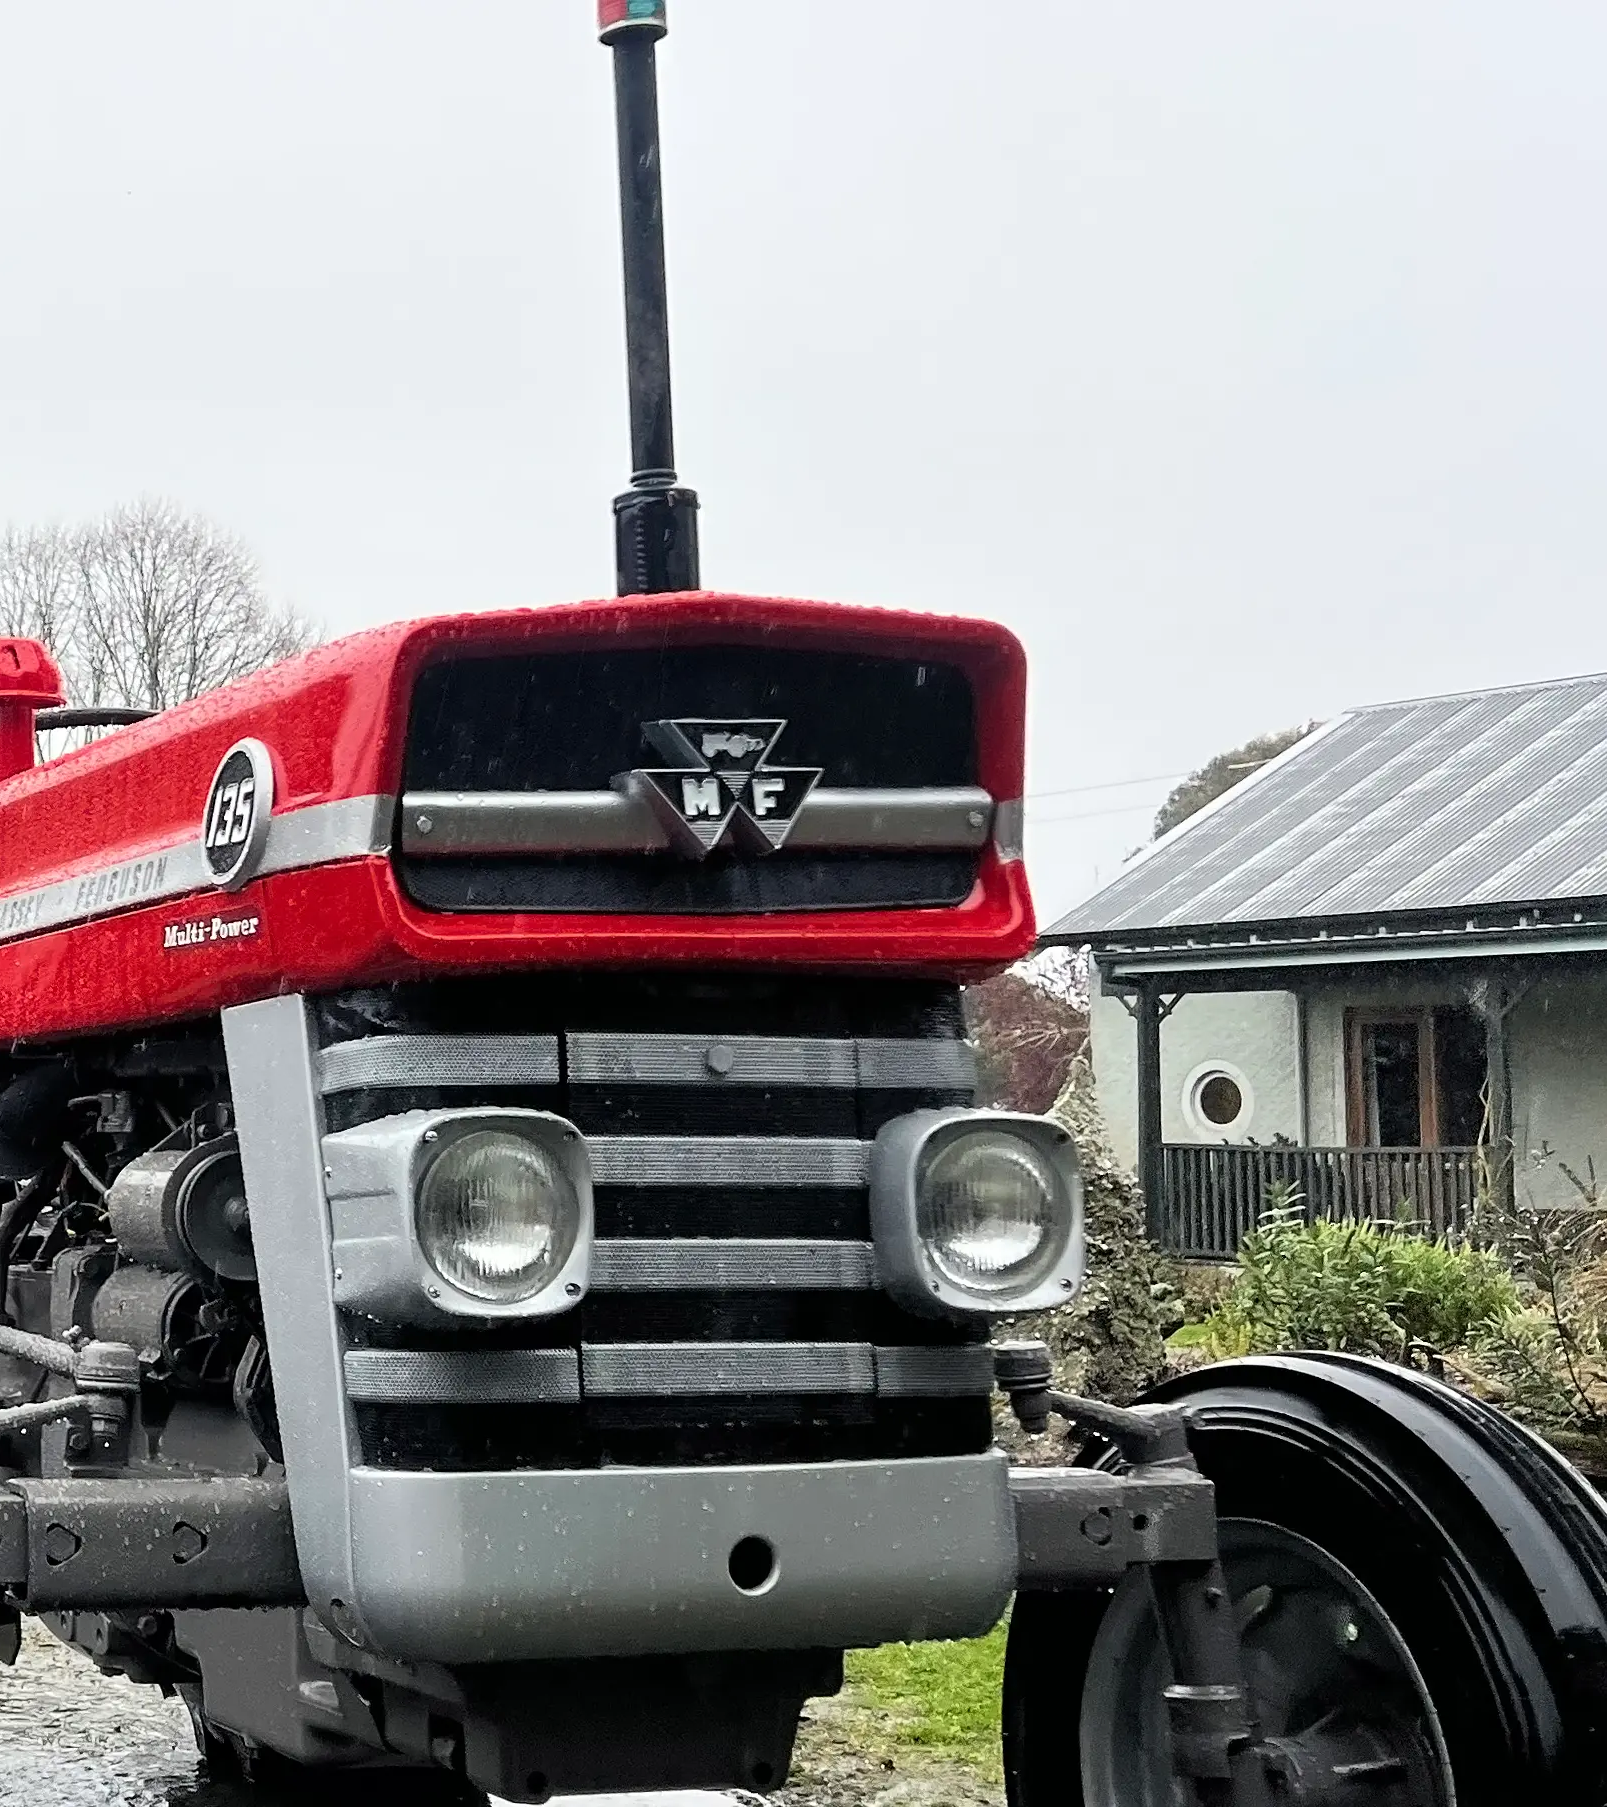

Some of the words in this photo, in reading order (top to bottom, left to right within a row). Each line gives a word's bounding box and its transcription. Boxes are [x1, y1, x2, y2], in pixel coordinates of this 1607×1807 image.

[205, 777, 255, 848] 135
[74, 856, 168, 912] FERGUSON
[163, 917, 260, 948] Multi-Power
